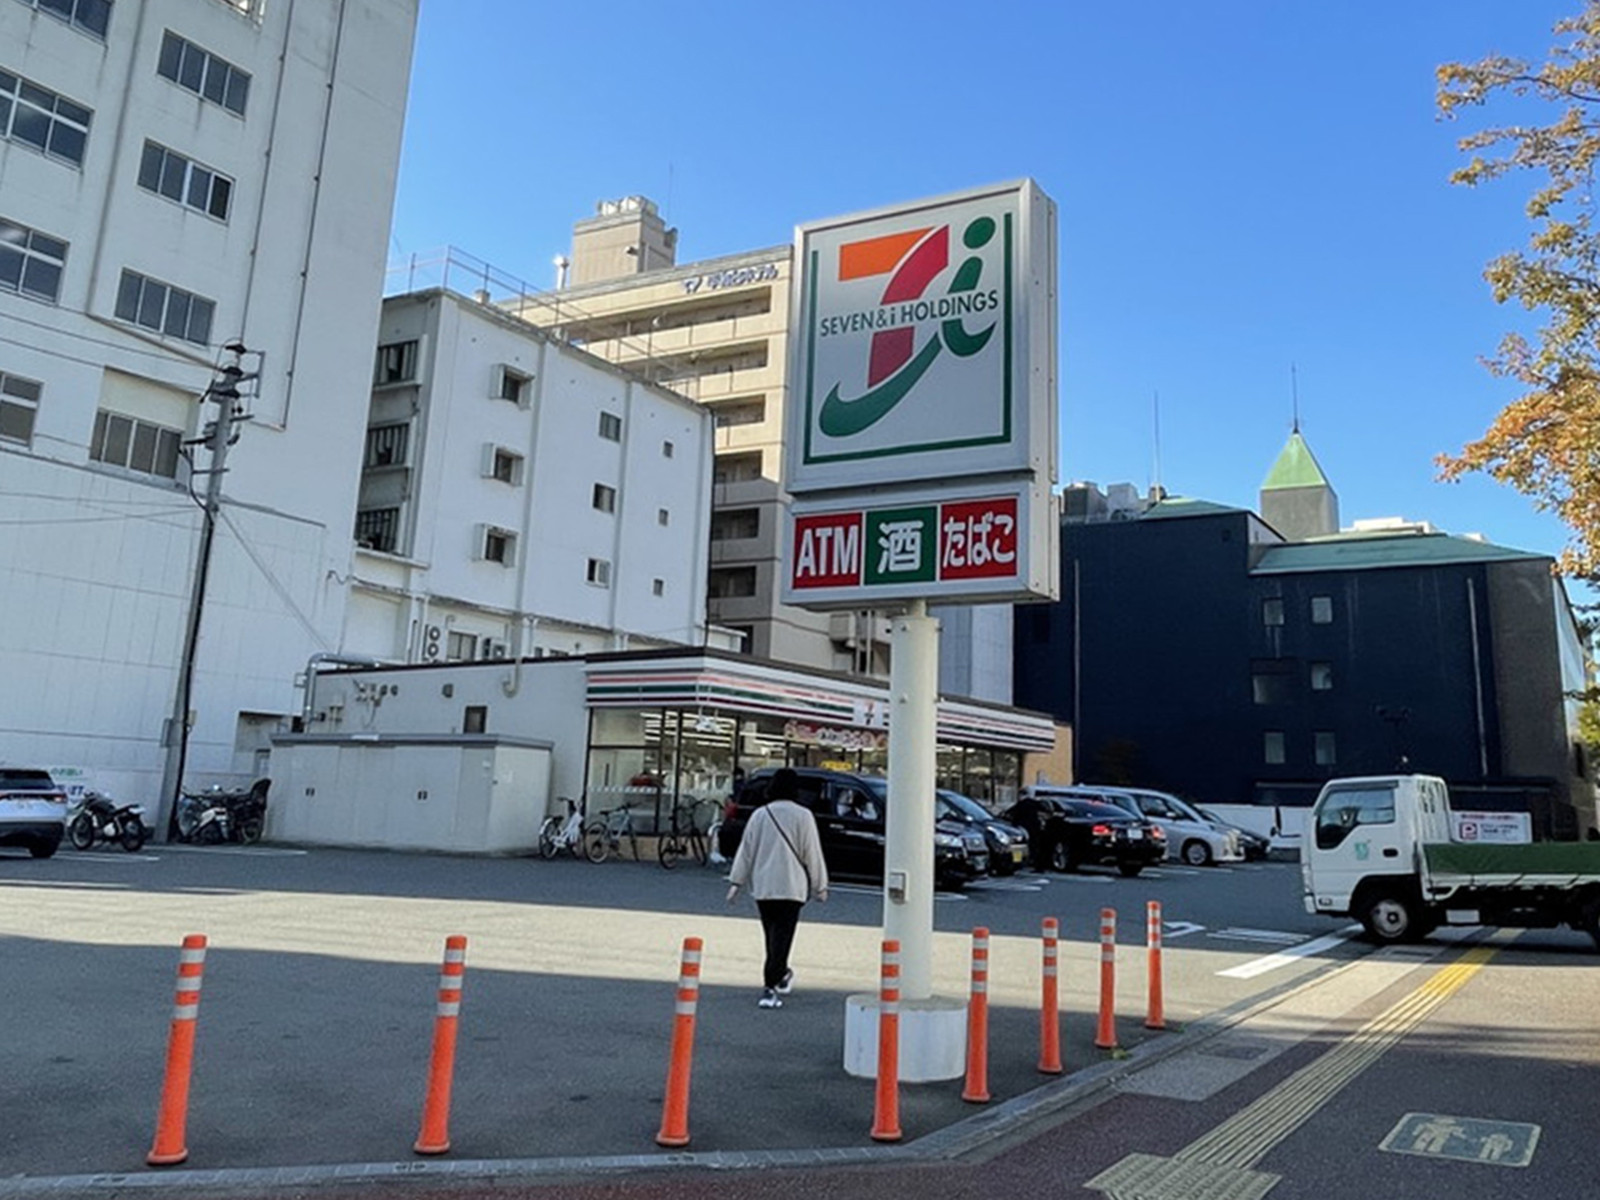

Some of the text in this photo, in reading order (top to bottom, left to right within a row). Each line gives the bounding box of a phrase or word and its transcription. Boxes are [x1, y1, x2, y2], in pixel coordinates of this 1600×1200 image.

[900, 290, 998, 323] HOLDINGS
[796, 524, 859, 578] ATM
[878, 520, 924, 574] 酒
[942, 513, 1015, 568] たばこ
